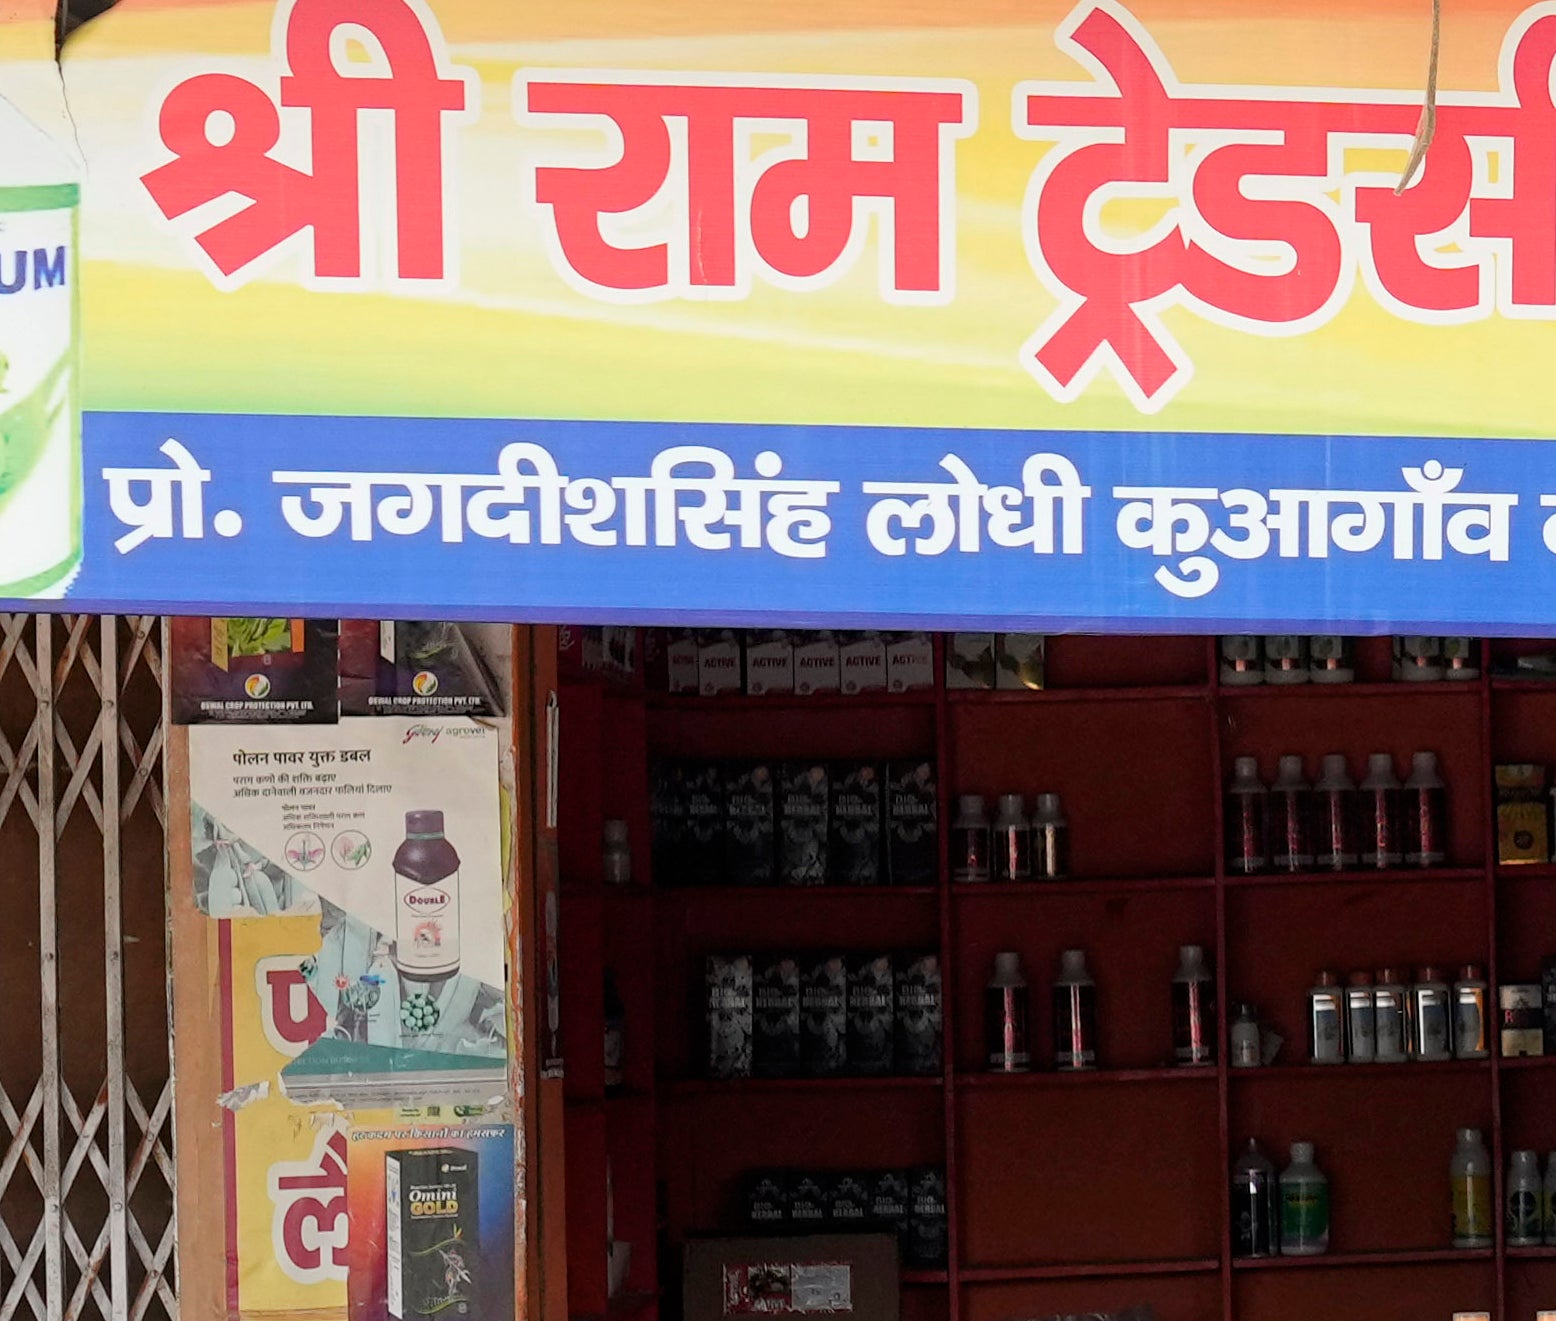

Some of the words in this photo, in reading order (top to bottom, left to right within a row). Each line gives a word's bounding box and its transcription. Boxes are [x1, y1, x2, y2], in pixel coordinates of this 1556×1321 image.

[140, 0, 464, 277] श्री
[528, 81, 962, 292] राम
[104, 442, 242, 554] प्रो.
[273, 444, 839, 559] जगदीशसिंह
[865, 452, 1089, 556] लोधी
[1117, 462, 1517, 597] कुआगाँव
[409, 1189, 457, 1203] Omini
[410, 1201, 458, 1216] GOLD
